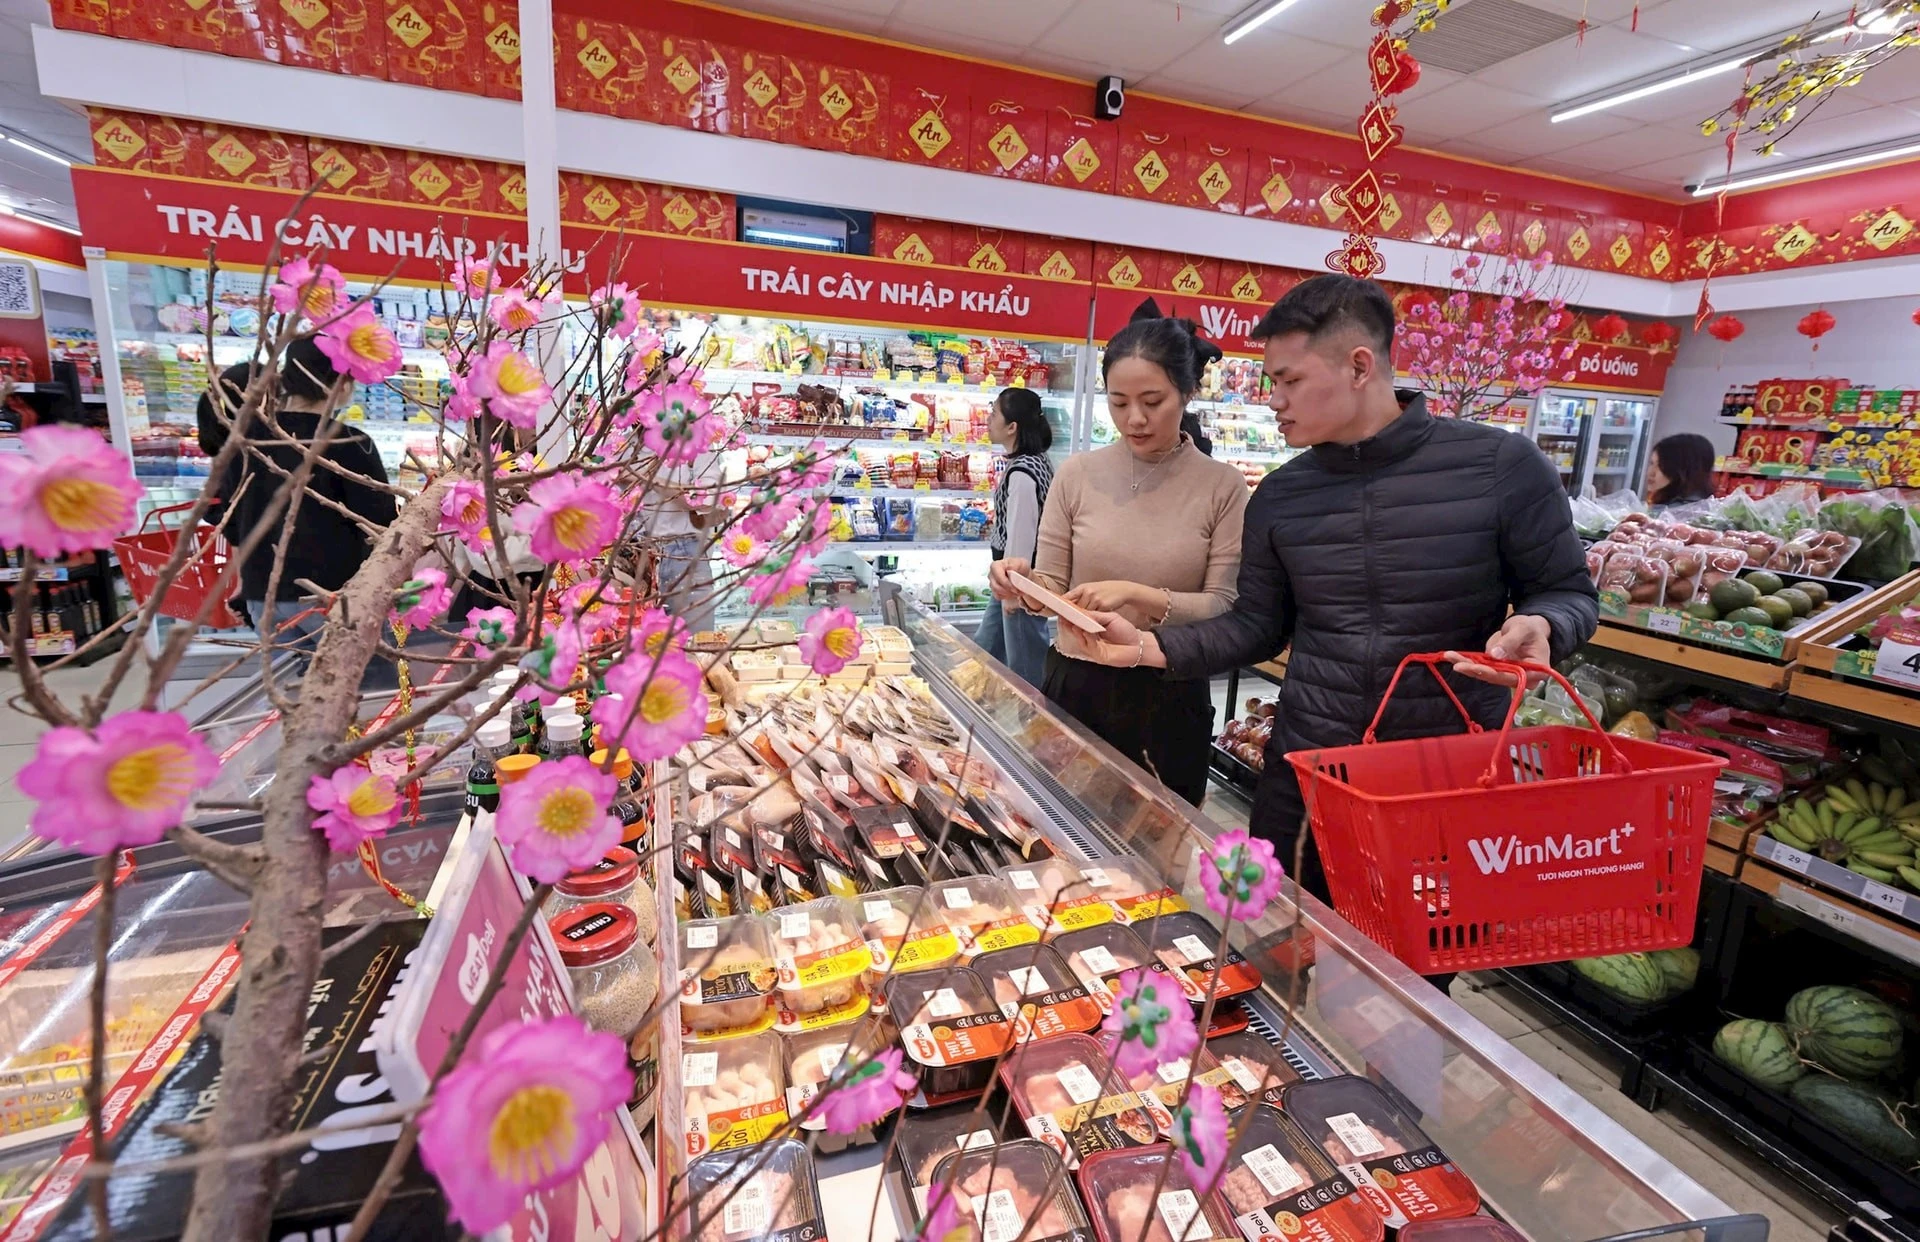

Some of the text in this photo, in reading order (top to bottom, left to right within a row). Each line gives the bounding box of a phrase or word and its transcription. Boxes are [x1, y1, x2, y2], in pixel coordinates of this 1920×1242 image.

[396, 12, 423, 31] An
[586, 46, 610, 64] An
[751, 76, 772, 94] An
[826, 90, 847, 106] An
[104, 126, 134, 145] An
[918, 122, 943, 143] An
[218, 142, 246, 160] An
[996, 135, 1019, 154] An
[418, 168, 443, 185] An
[1141, 160, 1162, 180] An
[1206, 171, 1225, 188] An
[590, 190, 613, 208] An
[670, 201, 690, 217] An
[1874, 220, 1901, 236] An
[157, 204, 263, 242] TRÁI
[274, 214, 357, 251] CÂY
[486, 242, 586, 275] KHU
[1783, 234, 1806, 250] An
[902, 244, 925, 263] An
[976, 254, 999, 272] An
[1048, 260, 1068, 278] An
[1115, 266, 1136, 284] An
[1178, 273, 1198, 290] An
[741, 265, 1031, 317] TRÁI CÂY NHẬP KHẨU
[1238, 281, 1256, 298] An
[1580, 352, 1639, 377] ĐỒ UỐNG
[1467, 822, 1636, 875] WinMart+
